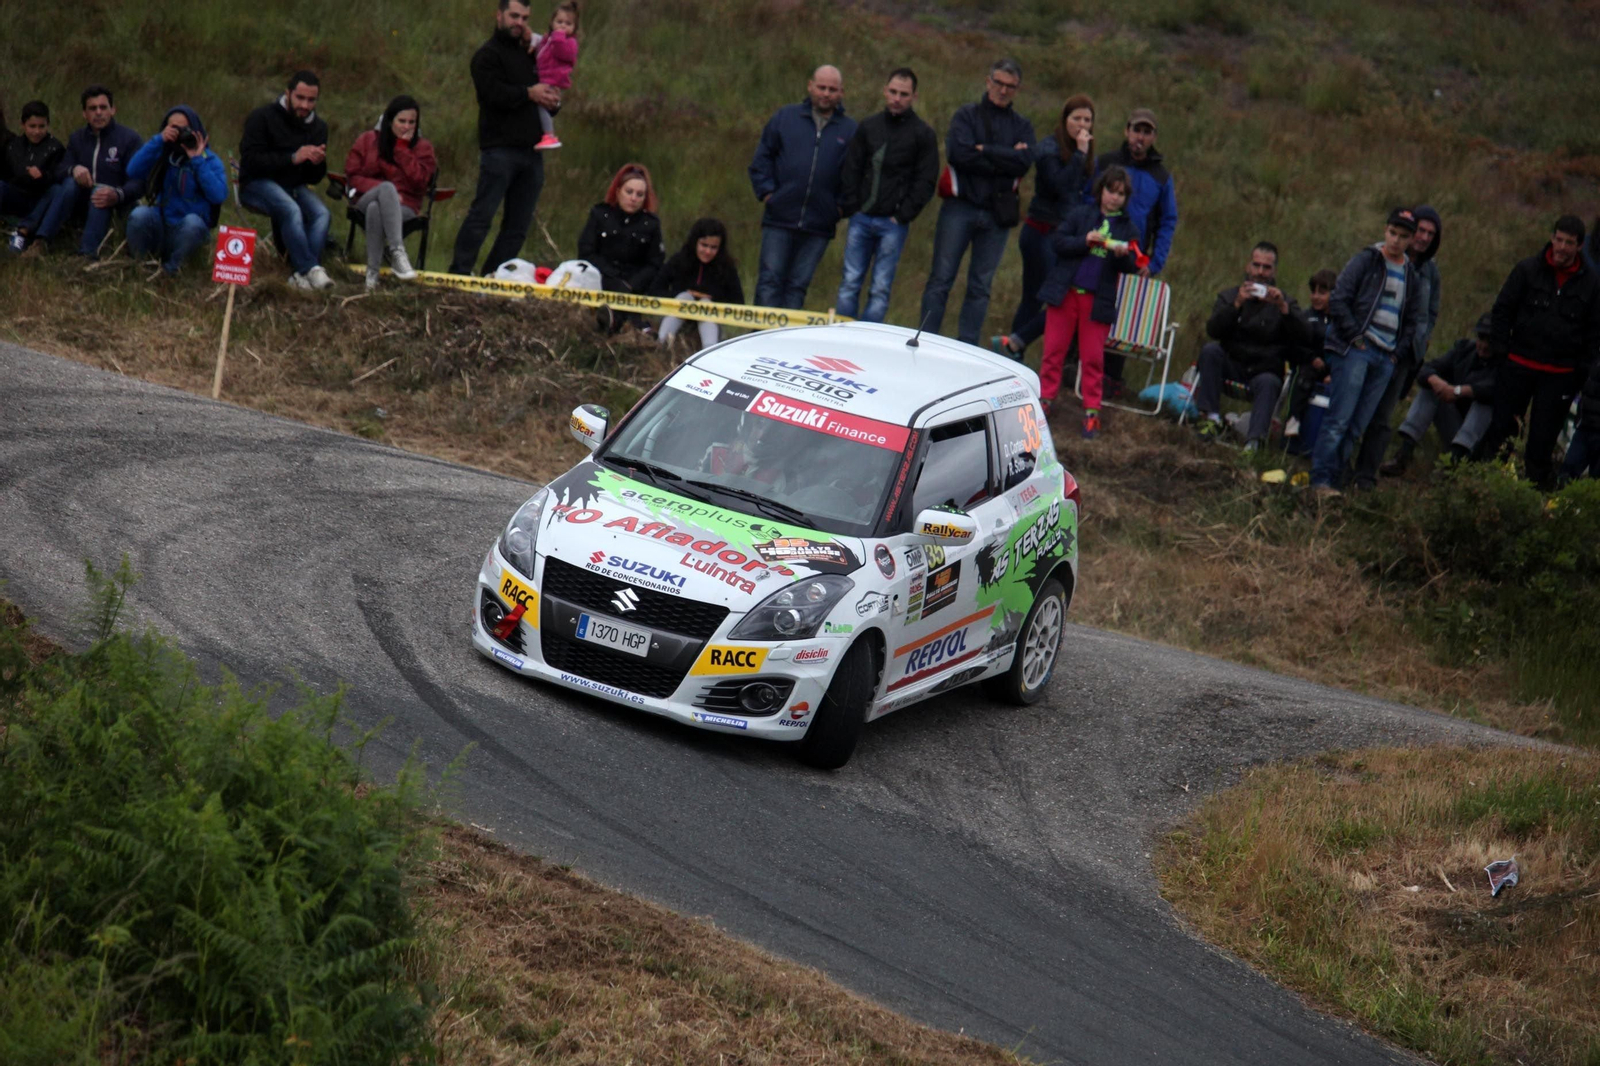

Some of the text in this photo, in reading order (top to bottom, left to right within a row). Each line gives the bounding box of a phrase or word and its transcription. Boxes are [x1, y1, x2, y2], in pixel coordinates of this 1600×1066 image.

[551, 288, 592, 301] ZONA
[596, 292, 662, 310] PUBLICO
[678, 303, 720, 318] ZONA
[723, 308, 789, 327] PUBLICO
[685, 383, 714, 396] SUZUKI
[740, 375, 845, 408] GRUPO SERGIO LUINTRA
[746, 364, 855, 400] Sergio
[755, 357, 878, 394] SUZUKI
[570, 416, 595, 438] allycar
[757, 396, 887, 445] Suzuki Finance
[1017, 404, 1040, 453] 35
[621, 489, 750, 529] aceroplus
[923, 522, 973, 539] Rallycar
[1013, 502, 1060, 570] TERZAS
[1036, 528, 1062, 561] RALLY
[607, 555, 687, 588] SUZUKI
[906, 549, 923, 568] OMP
[925, 544, 946, 569] 35
[585, 562, 682, 595] RED DE CONCESIONARIOS
[680, 552, 757, 595] Luintra
[502, 578, 534, 611] RACC
[591, 621, 619, 642] 1370
[622, 632, 647, 650] HGP
[905, 627, 969, 675] REPSOL
[496, 651, 523, 667] MICHELIN
[710, 649, 757, 668] RACC
[795, 647, 829, 660] disiclin
[560, 673, 645, 705] www.suzuki.es
[704, 715, 746, 727] MICHELIN
[779, 719, 809, 728] REPSOL
